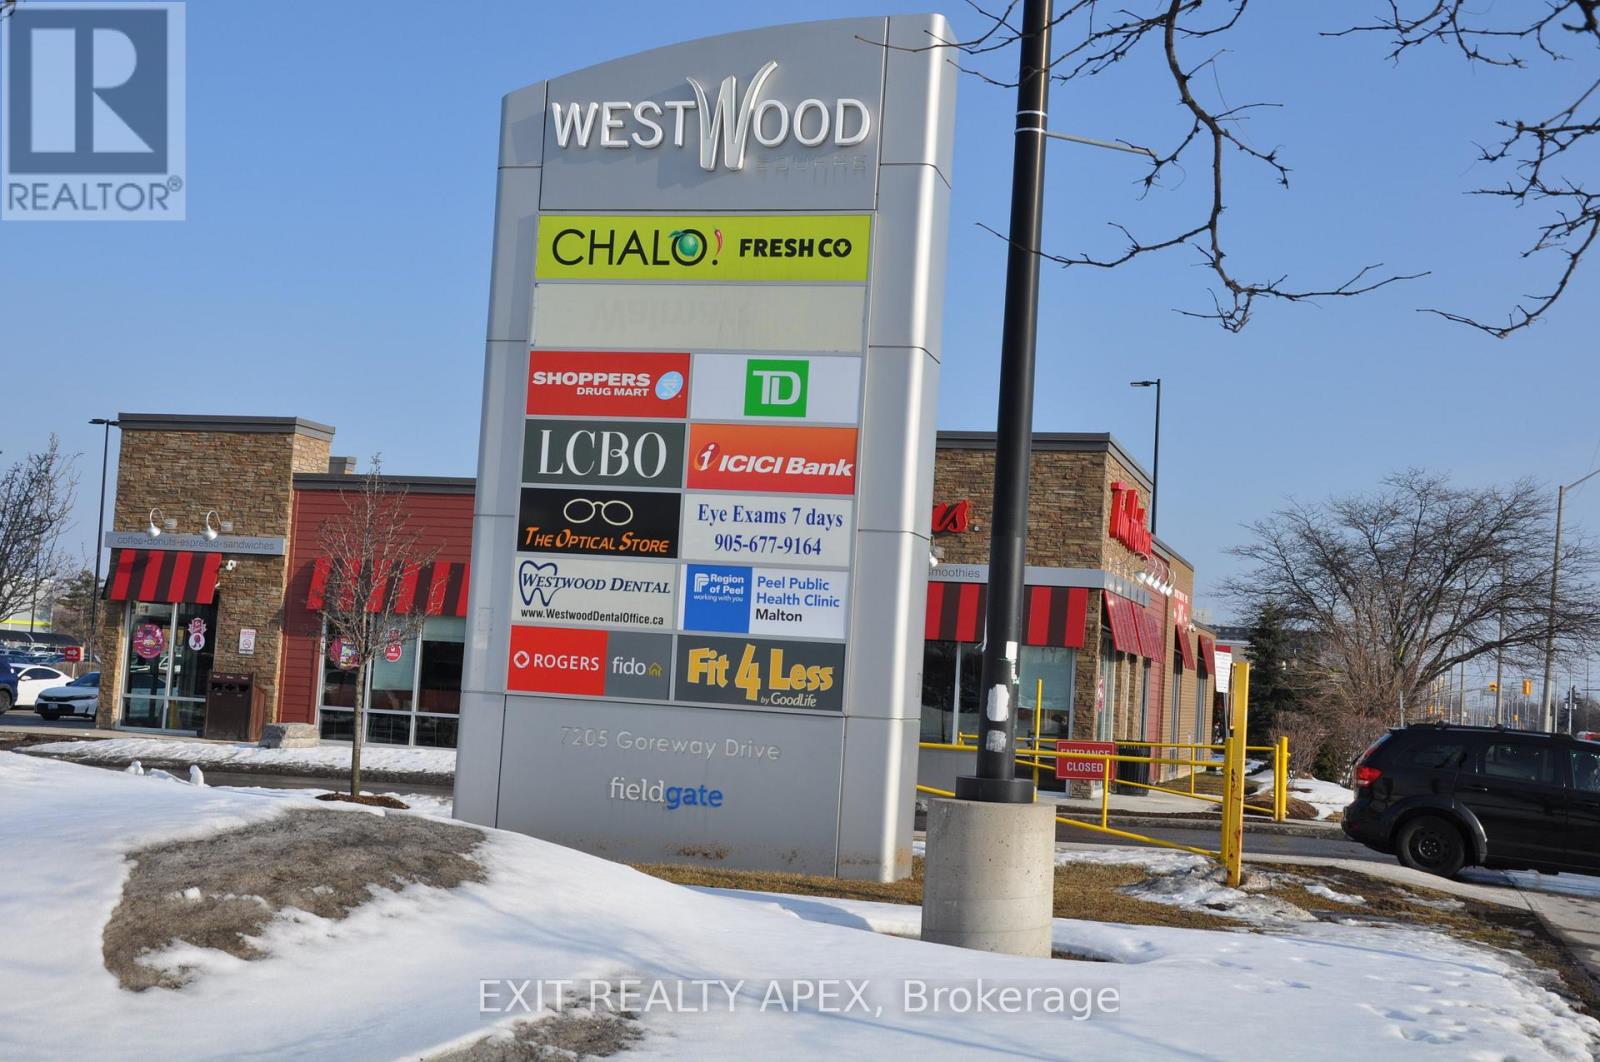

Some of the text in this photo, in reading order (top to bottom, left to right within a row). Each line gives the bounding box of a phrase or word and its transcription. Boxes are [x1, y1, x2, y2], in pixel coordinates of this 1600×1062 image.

[551, 60, 872, 171] WESTWOOD
[552, 227, 724, 267] CHALO!
[532, 371, 650, 387] SHOPPERS
[752, 370, 802, 406] TD
[576, 387, 650, 397] DRUG MART
[537, 429, 667, 479] LCBO
[718, 455, 784, 474] ICICI
[785, 457, 854, 477] Bank
[697, 504, 844, 532] Eye Exams 7 days
[525, 527, 670, 553] THE OPTICAL STORE
[714, 533, 822, 556] 905-677-9164
[522, 573, 671, 595] WESTWOOD DENTAL
[711, 573, 745, 585] Region
[757, 576, 830, 591] Peel Public
[710, 585, 744, 595] of Peel
[756, 593, 840, 608] Health Clinic
[521, 608, 664, 626] www.WestwoodDentalOffice.ca
[755, 608, 803, 622] Malton
[533, 653, 600, 671] ROGERS
[612, 656, 646, 676] fido
[687, 643, 834, 701] Fit 4 Less
[760, 692, 817, 707] by GoodLife
[560, 726, 781, 761] 7205 Goreway Drive
[1066, 761, 1104, 773] CLOSED
[609, 776, 723, 811] fieldgate
